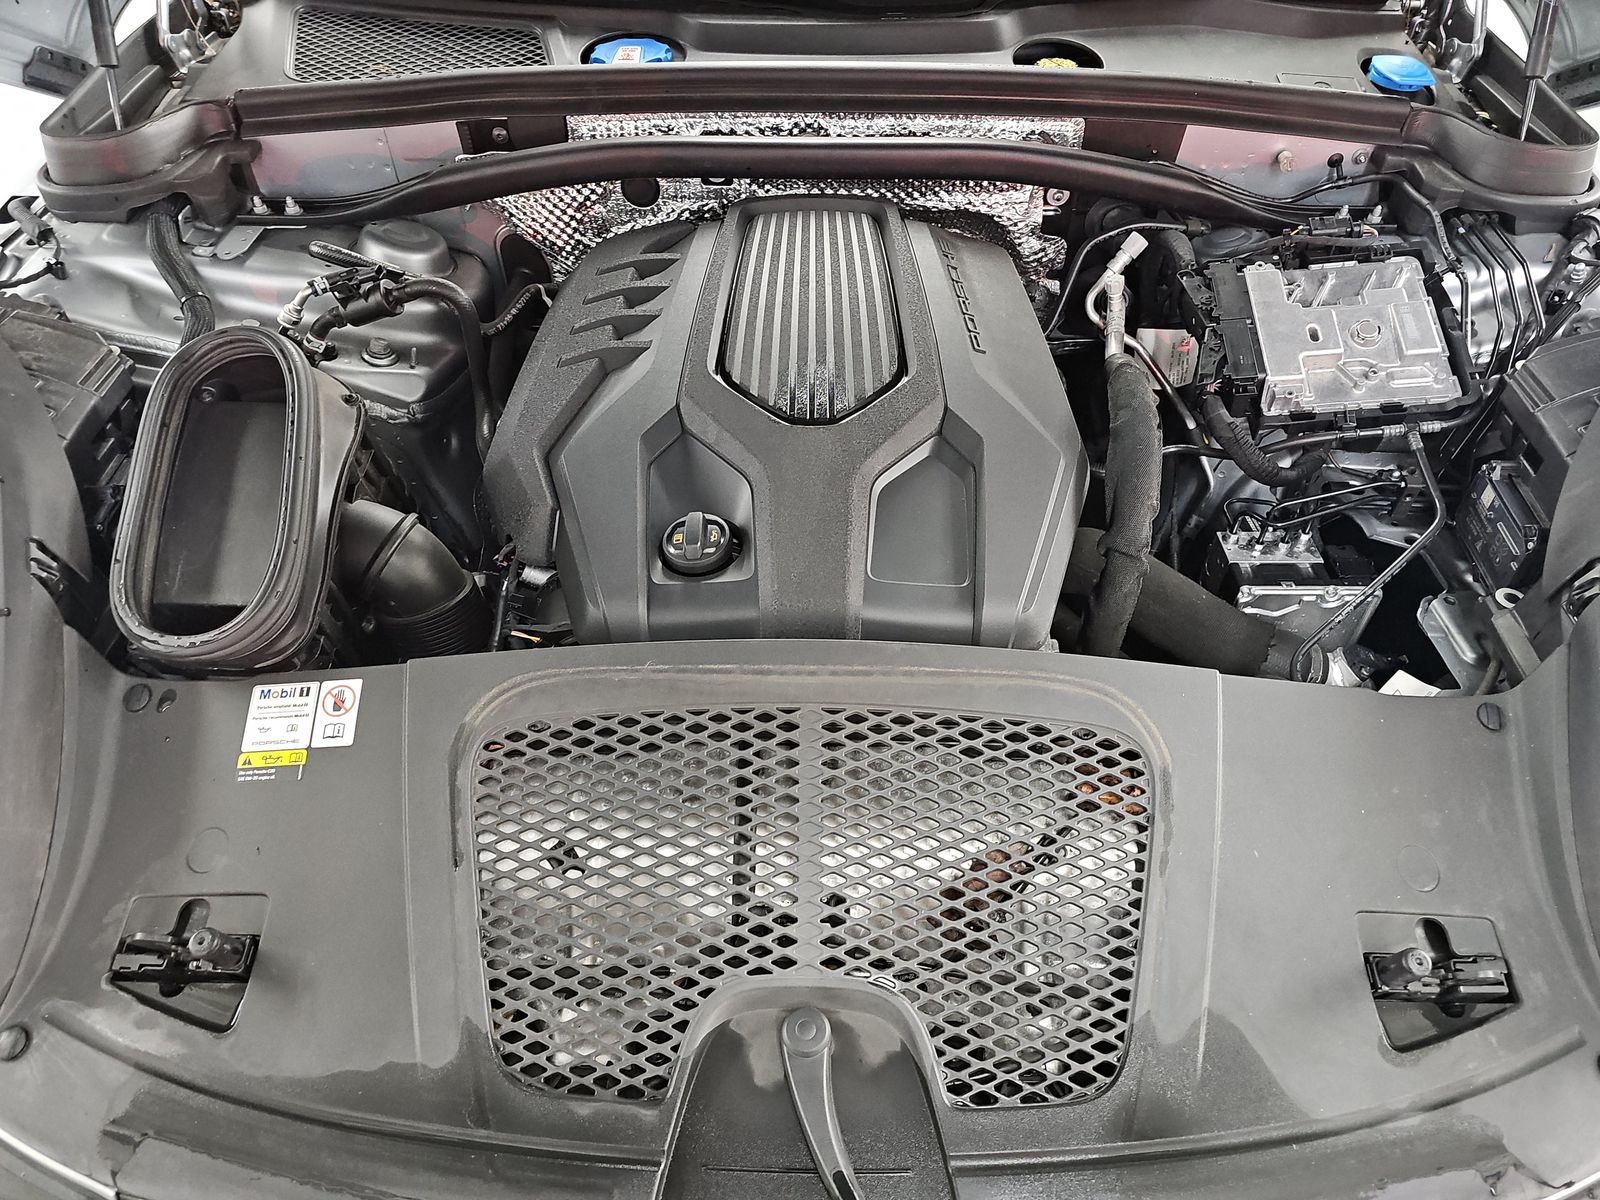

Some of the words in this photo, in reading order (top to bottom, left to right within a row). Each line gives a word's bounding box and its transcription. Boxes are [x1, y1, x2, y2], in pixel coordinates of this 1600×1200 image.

[938, 237, 986, 355] PORSCHE
[259, 687, 296, 700] Mobil
[299, 686, 311, 697] 1
